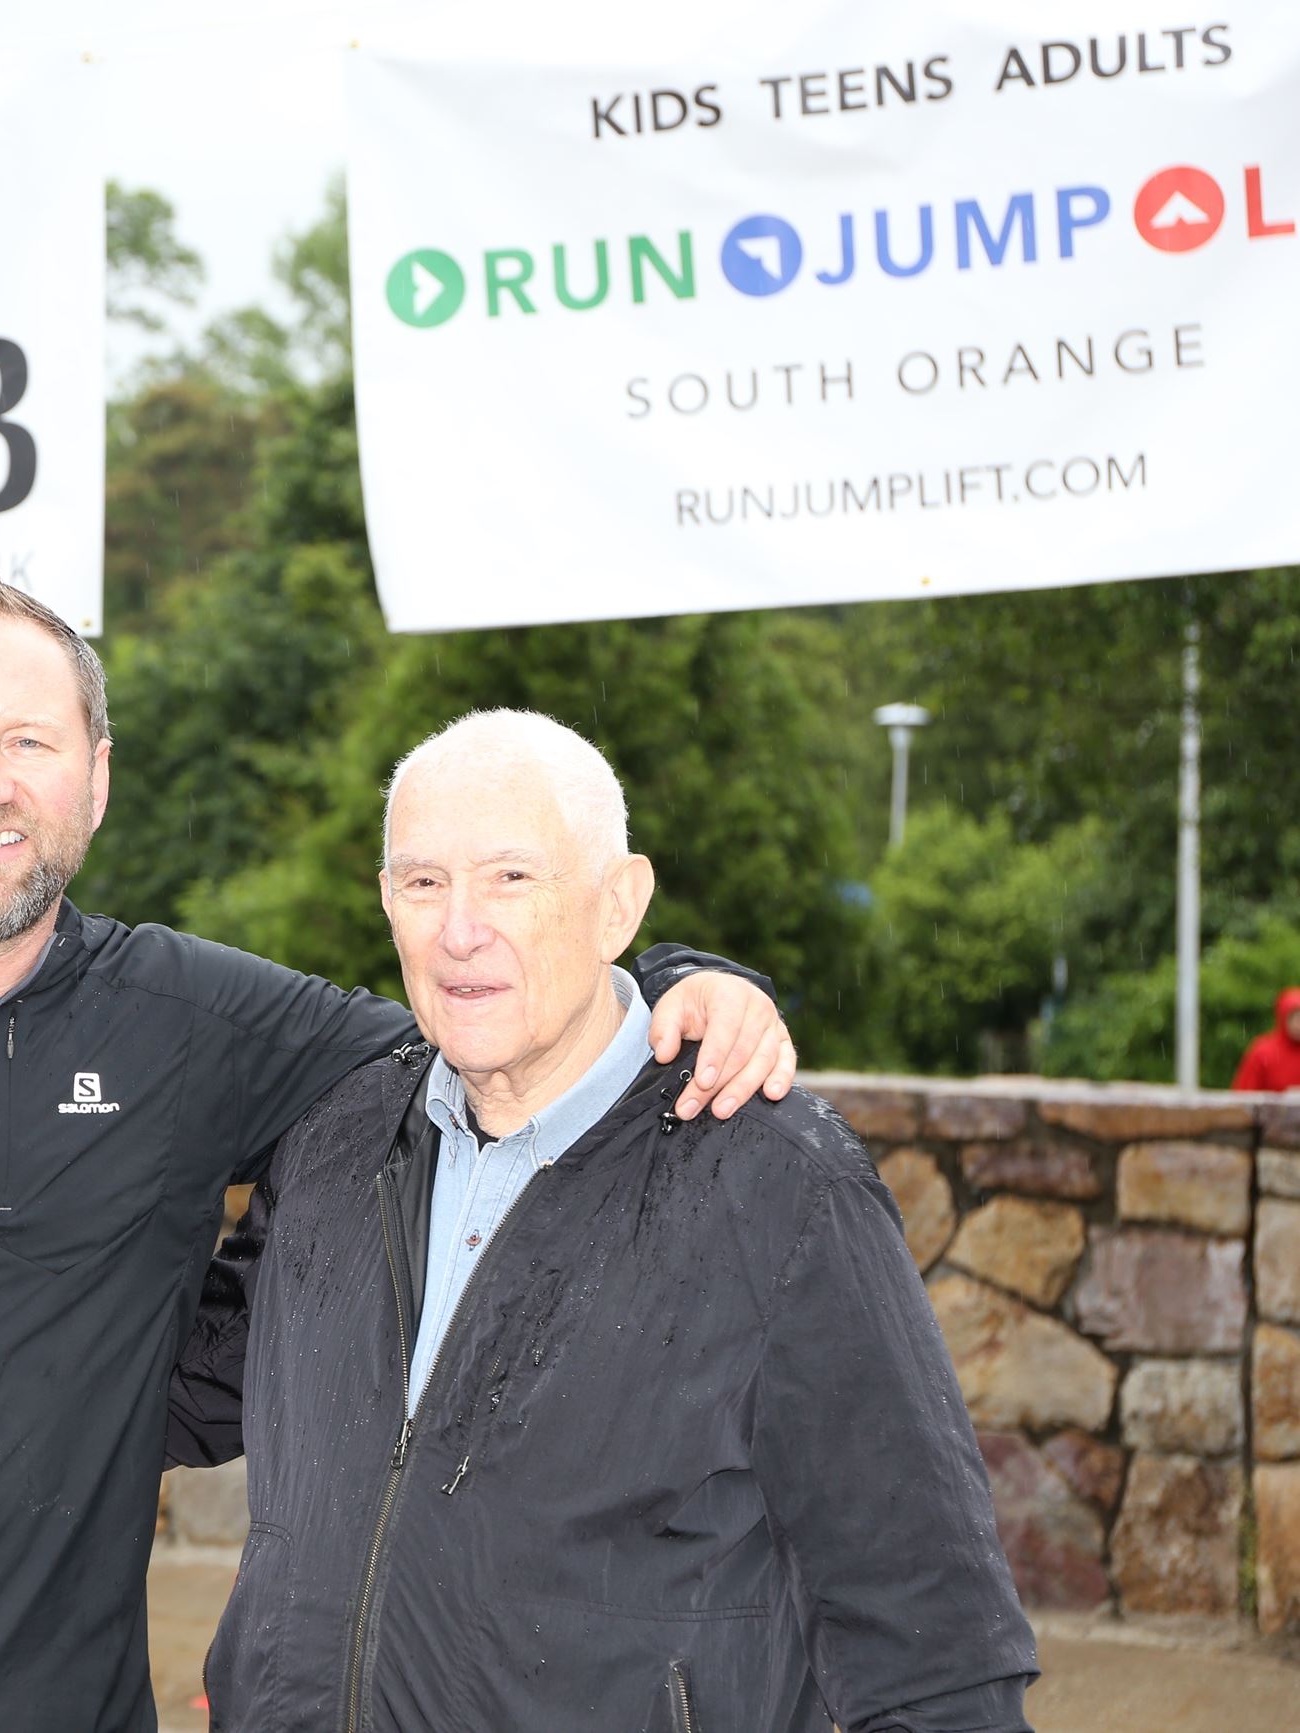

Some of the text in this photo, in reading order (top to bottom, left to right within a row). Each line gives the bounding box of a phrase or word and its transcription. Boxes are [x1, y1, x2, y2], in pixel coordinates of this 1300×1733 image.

[590, 23, 1233, 140] KIDS TEENS ADULTS
[483, 229, 697, 318] RUN
[814, 184, 1112, 287] JUMP
[626, 324, 1207, 419] SOUTH ORANGE
[675, 452, 1148, 526] RUNJUMPLIFT.COM
